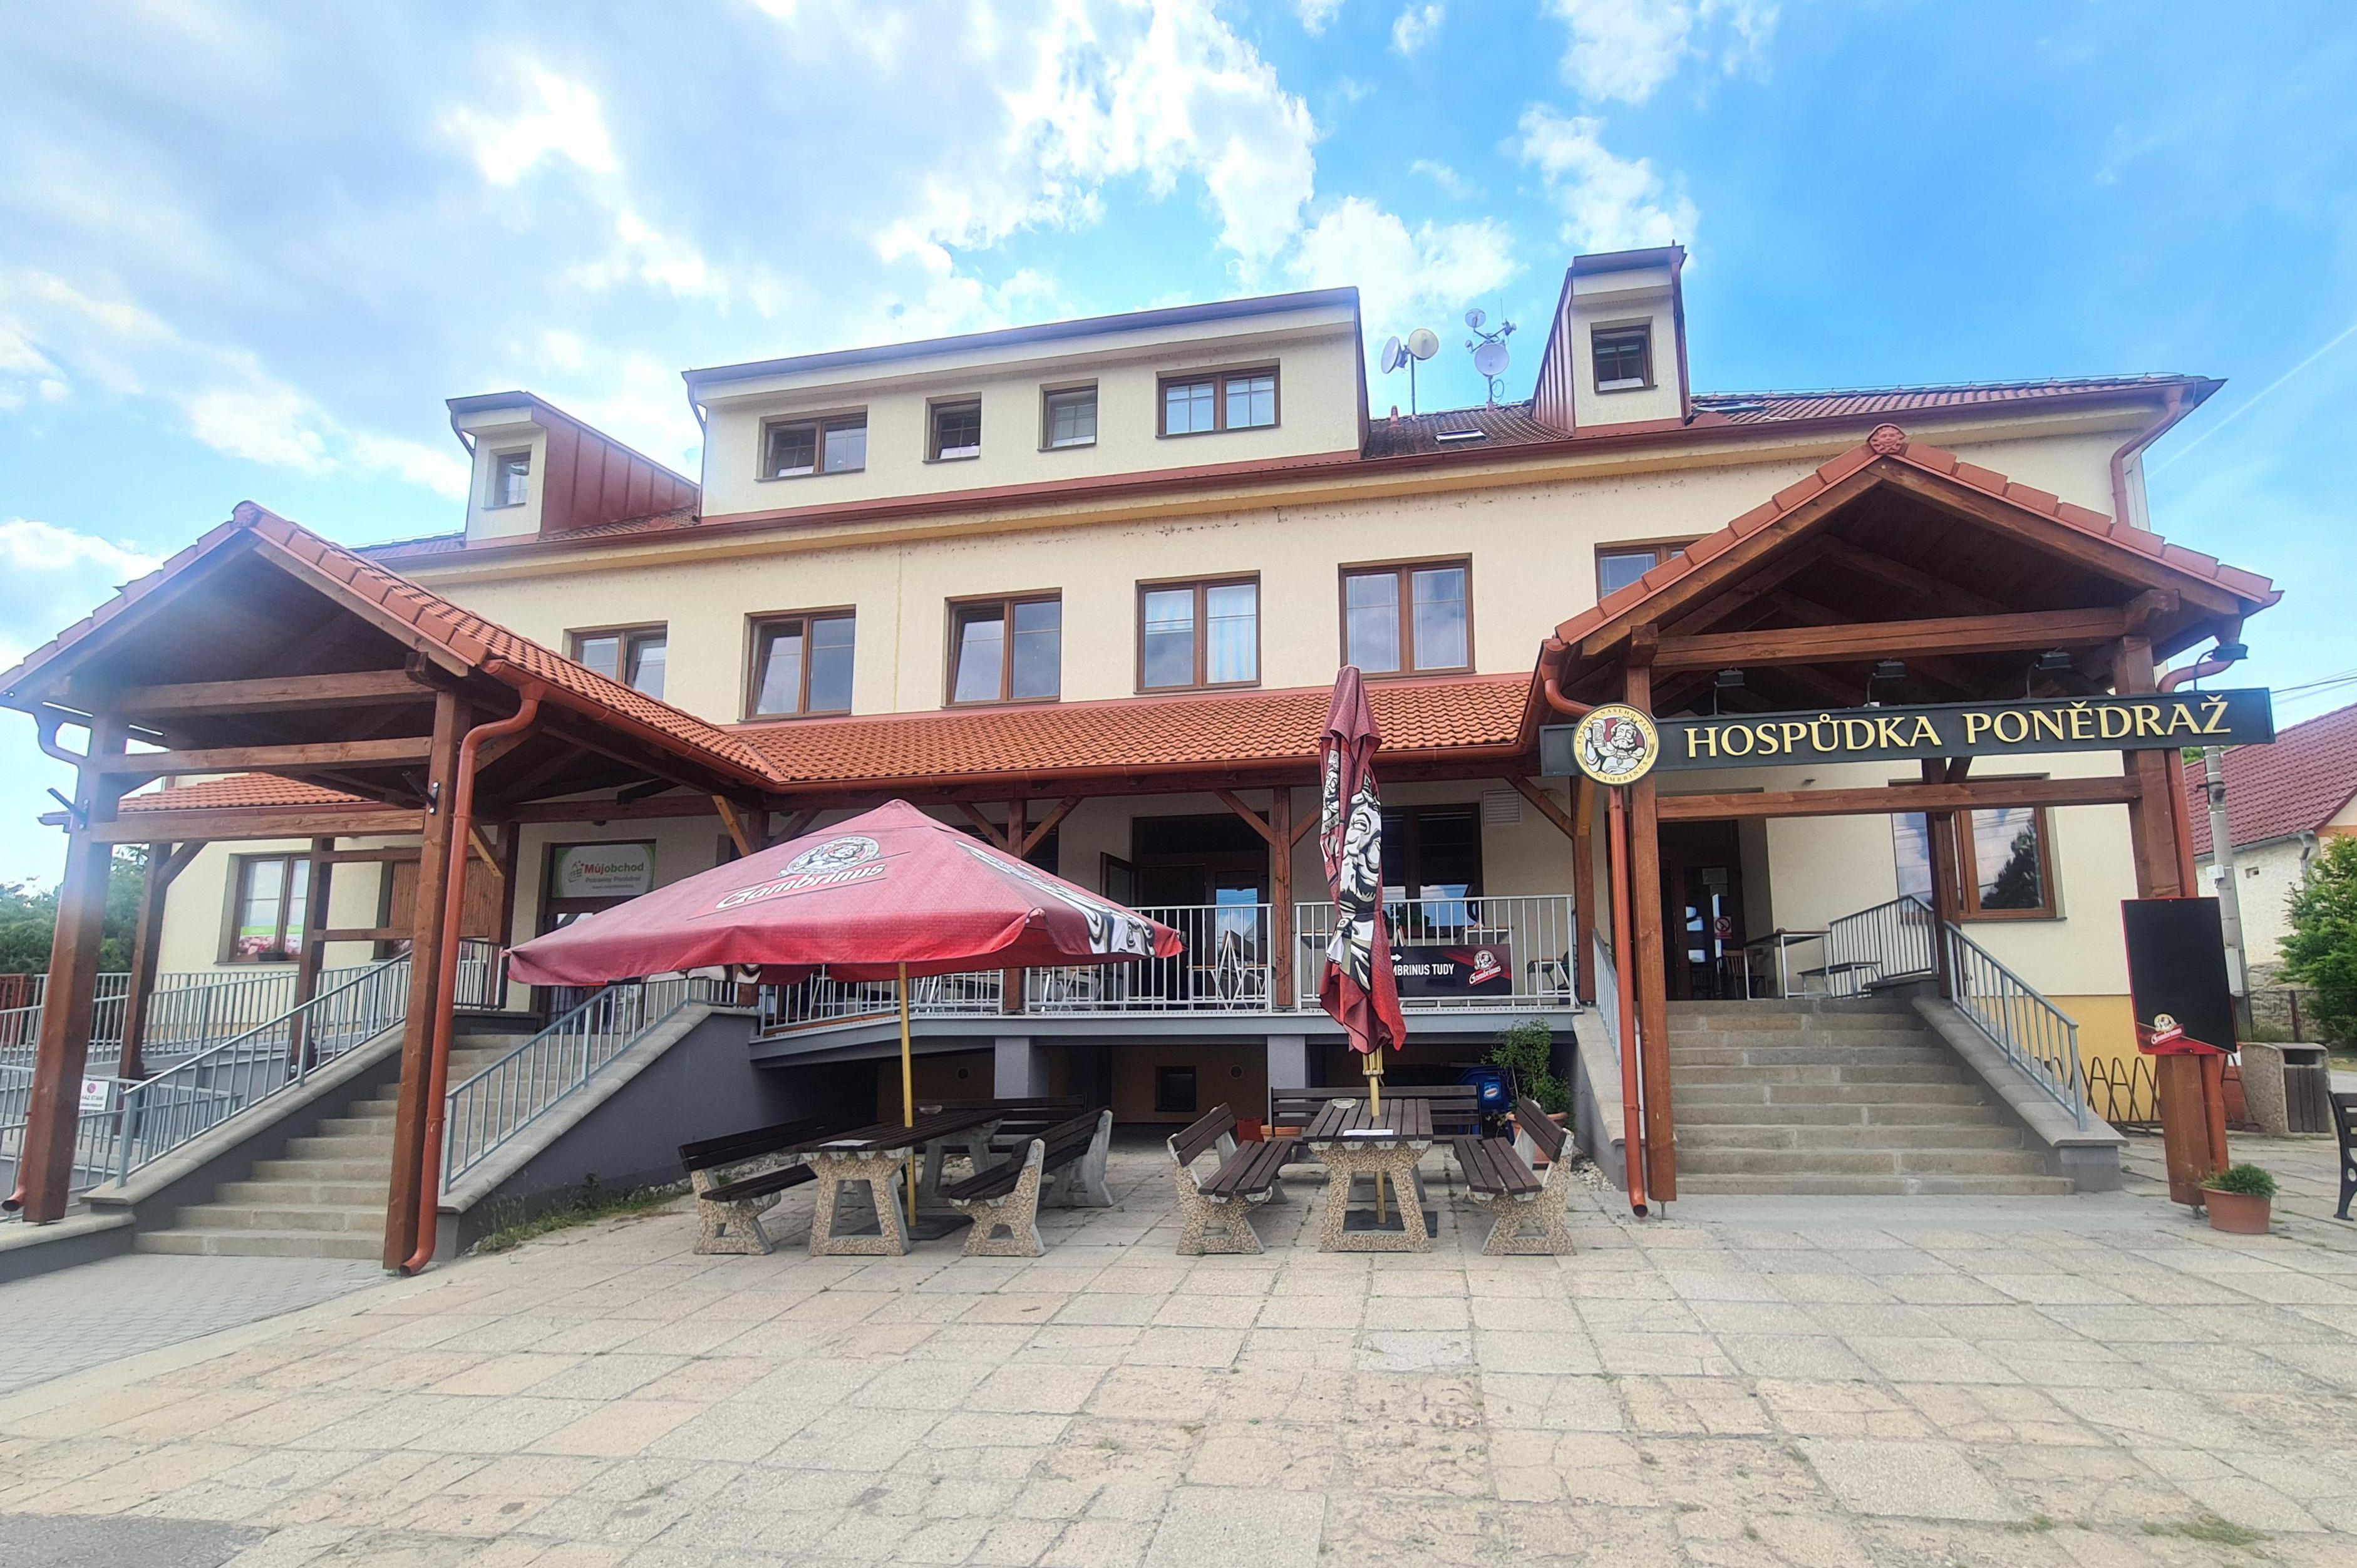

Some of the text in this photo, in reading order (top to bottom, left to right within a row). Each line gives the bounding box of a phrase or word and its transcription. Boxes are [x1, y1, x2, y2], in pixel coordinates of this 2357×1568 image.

[1683, 694, 2232, 758] HOSPŮDKA PONĚDRAŽ
[1596, 761, 1649, 782] GAMBRINUS
[715, 864, 887, 909] Gambrinus
[1431, 963, 1455, 975] TUDY
[1468, 965, 1501, 985] Gambrinus
